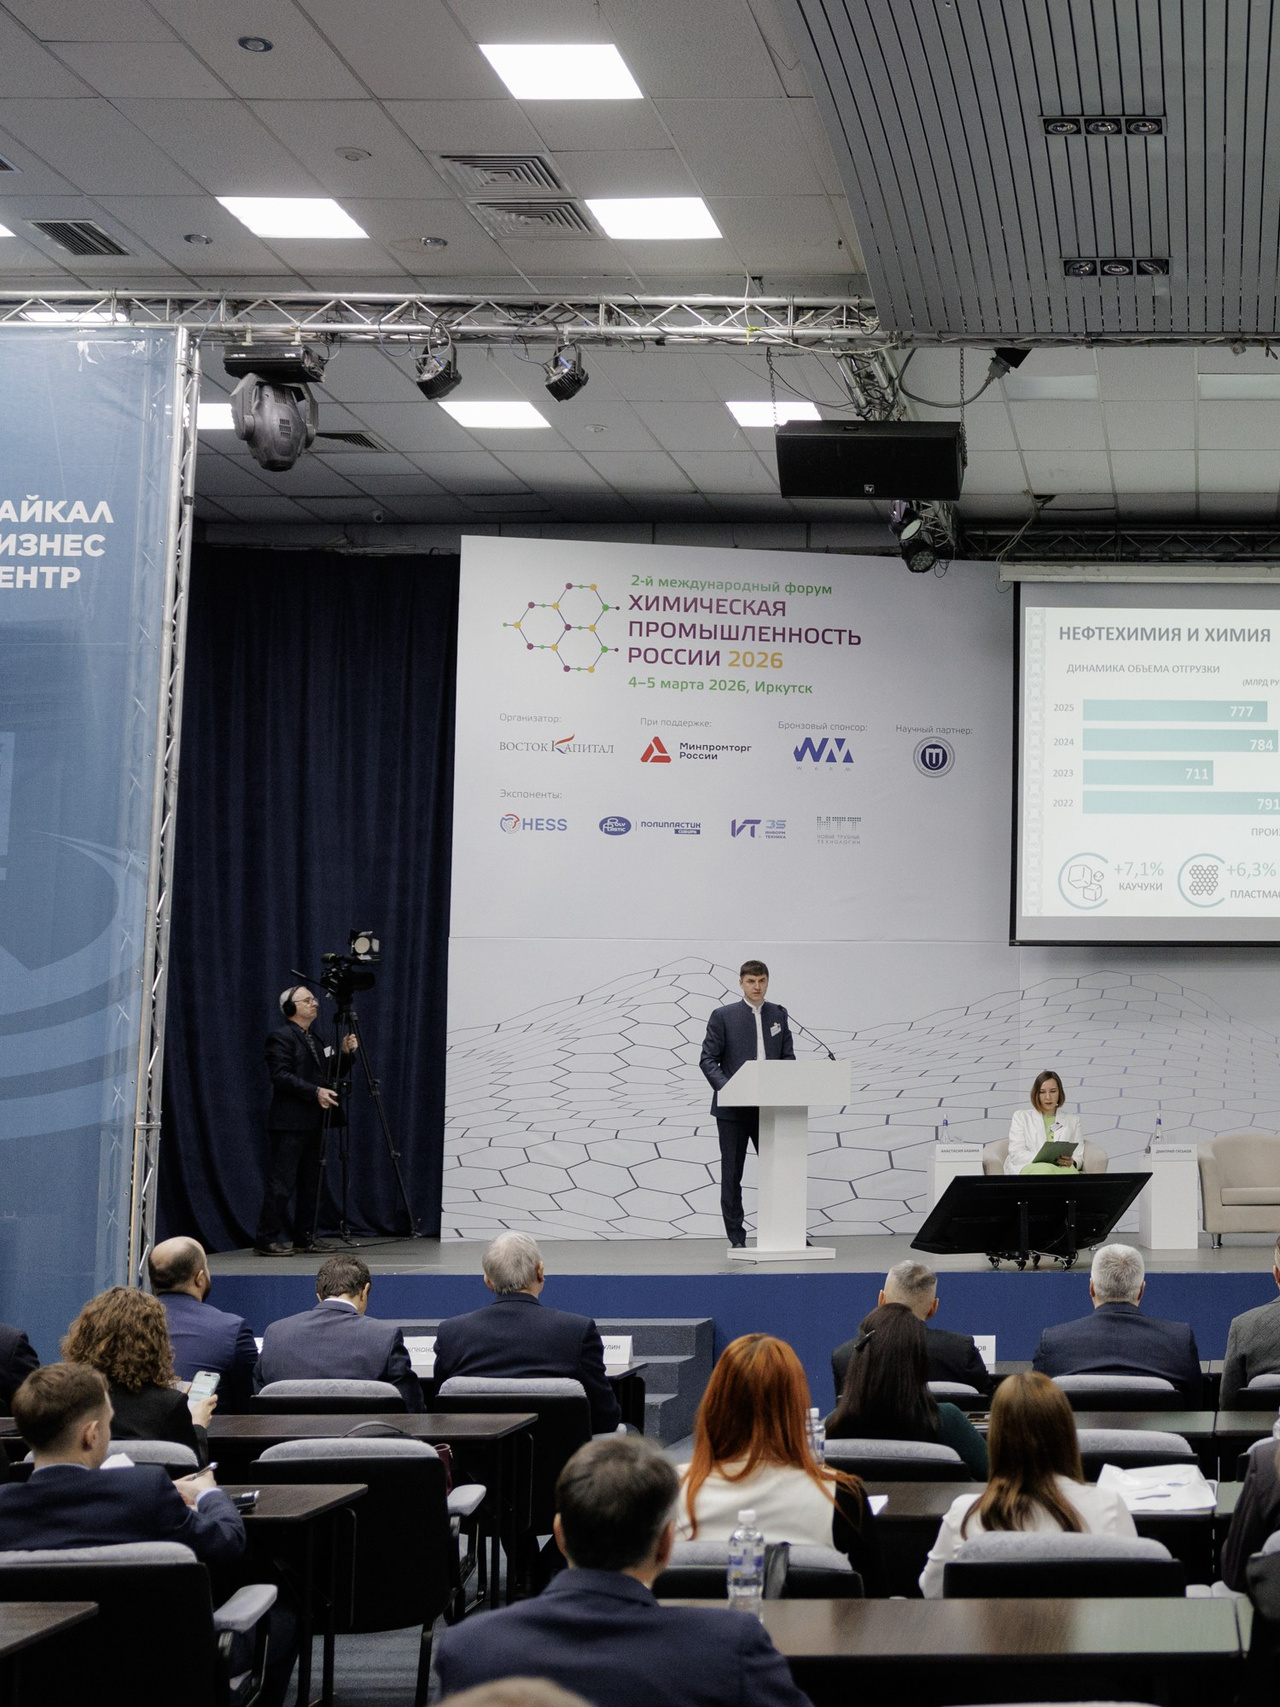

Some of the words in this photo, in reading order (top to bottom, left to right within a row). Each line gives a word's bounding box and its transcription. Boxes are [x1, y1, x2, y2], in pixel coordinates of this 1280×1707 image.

[631, 574, 654, 587] 2-й
[658, 577, 780, 593] международный
[785, 581, 832, 596] форум
[628, 594, 786, 617] ХИМИЧЕСКАЯ
[629, 620, 862, 646] ПРОМЫШЛЕННОСТЬ
[1059, 625, 1181, 642] НЕФТЕХИМИЯ
[1187, 628, 1199, 641] И
[1204, 628, 1271, 643] ХИМИЯ
[628, 647, 720, 666] РОССИИ
[728, 651, 784, 669] 2026
[1066, 663, 1126, 674] ДИНАМИКА
[1127, 664, 1170, 674] ОБЪЕМА
[1172, 665, 1220, 674] ОТГРУЗКИ
[660, 680, 704, 692] марта
[709, 679, 750, 694] 2026,
[755, 681, 813, 696] Иркутск
[1242, 678, 1268, 688] (МЛРД
[1053, 704, 1075, 712] 2025
[1230, 706, 1254, 718] 777
[500, 713, 562, 725] Организатор:
[640, 718, 658, 728] При
[660, 719, 712, 728] поддержке:
[778, 721, 828, 731] Бронзовый
[830, 723, 868, 733] спонсор:
[895, 724, 934, 736] Научный
[936, 726, 973, 736] партнер:
[499, 741, 548, 752] ВОСТОК
[551, 734, 614, 754] КАПИТАЛ
[679, 742, 752, 752] Минпромторг
[1053, 738, 1075, 746] 2024
[1250, 739, 1274, 751] 784
[679, 752, 718, 760] России
[1052, 769, 1074, 777] 2023
[1185, 768, 1209, 780] 711
[500, 789, 563, 799] Экспоненты:
[1052, 799, 1074, 807] 2022
[1257, 798, 1280, 810] 791
[522, 818, 568, 831] HESS
[1114, 861, 1164, 879] +7,1%
[1226, 862, 1277, 879] +6,3%
[1119, 882, 1163, 891] КАУЧУКИ
